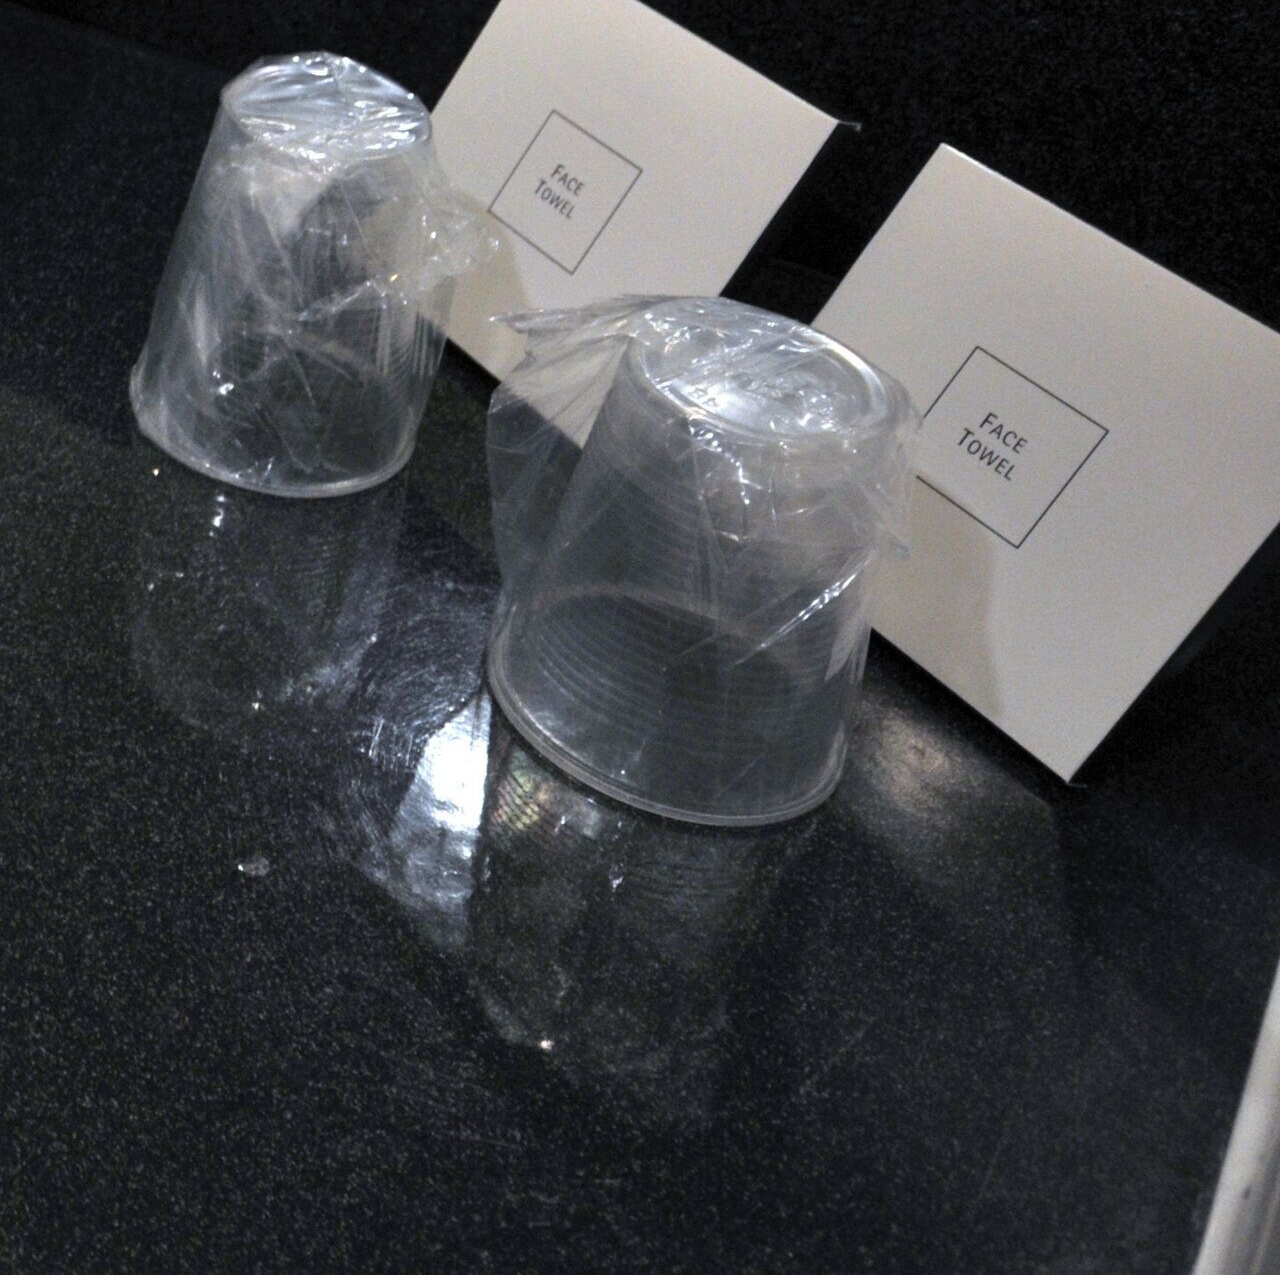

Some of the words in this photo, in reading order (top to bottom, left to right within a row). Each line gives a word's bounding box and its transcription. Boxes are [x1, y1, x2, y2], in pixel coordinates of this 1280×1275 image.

[535, 179, 575, 219] TOWEL
[551, 164, 584, 196] FACE
[981, 413, 1027, 453] FACE
[958, 428, 1016, 481] TOWEL
